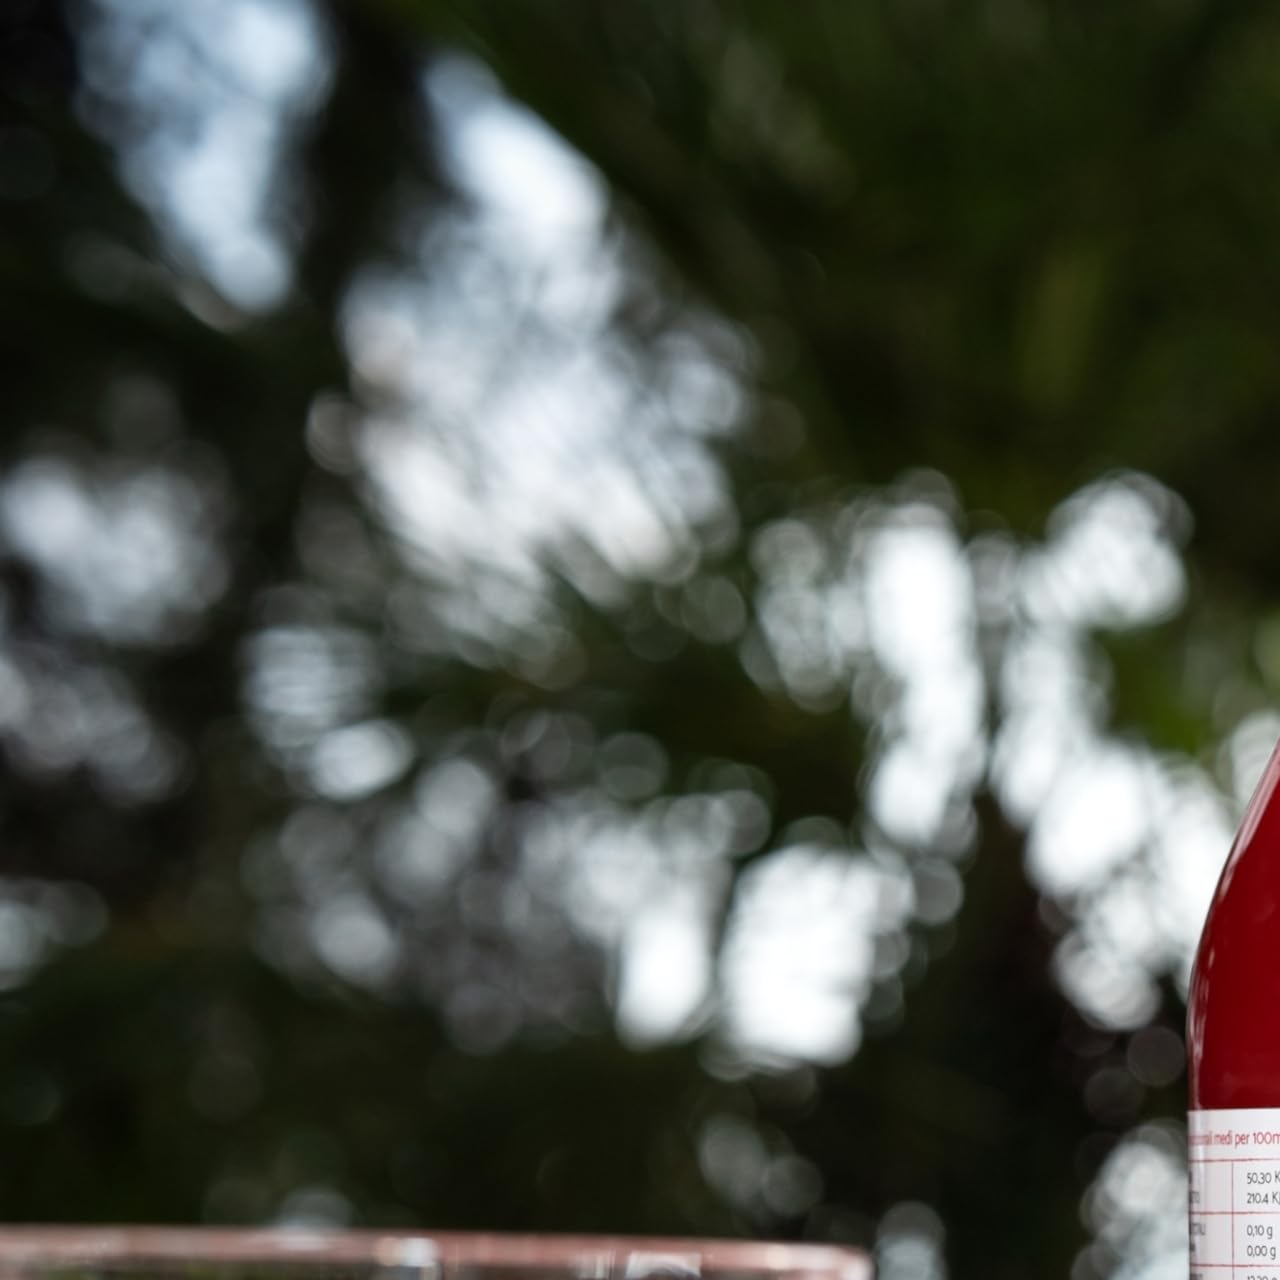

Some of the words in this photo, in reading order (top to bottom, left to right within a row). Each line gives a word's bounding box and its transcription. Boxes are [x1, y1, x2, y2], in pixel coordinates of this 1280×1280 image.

[1234, 1133, 1250, 1149] per
[1246, 1225, 1265, 1237] 0,10
[1266, 1226, 1273, 1240] g
[1247, 1245, 1267, 1257] 0,00
[1270, 1247, 1276, 1260] g
